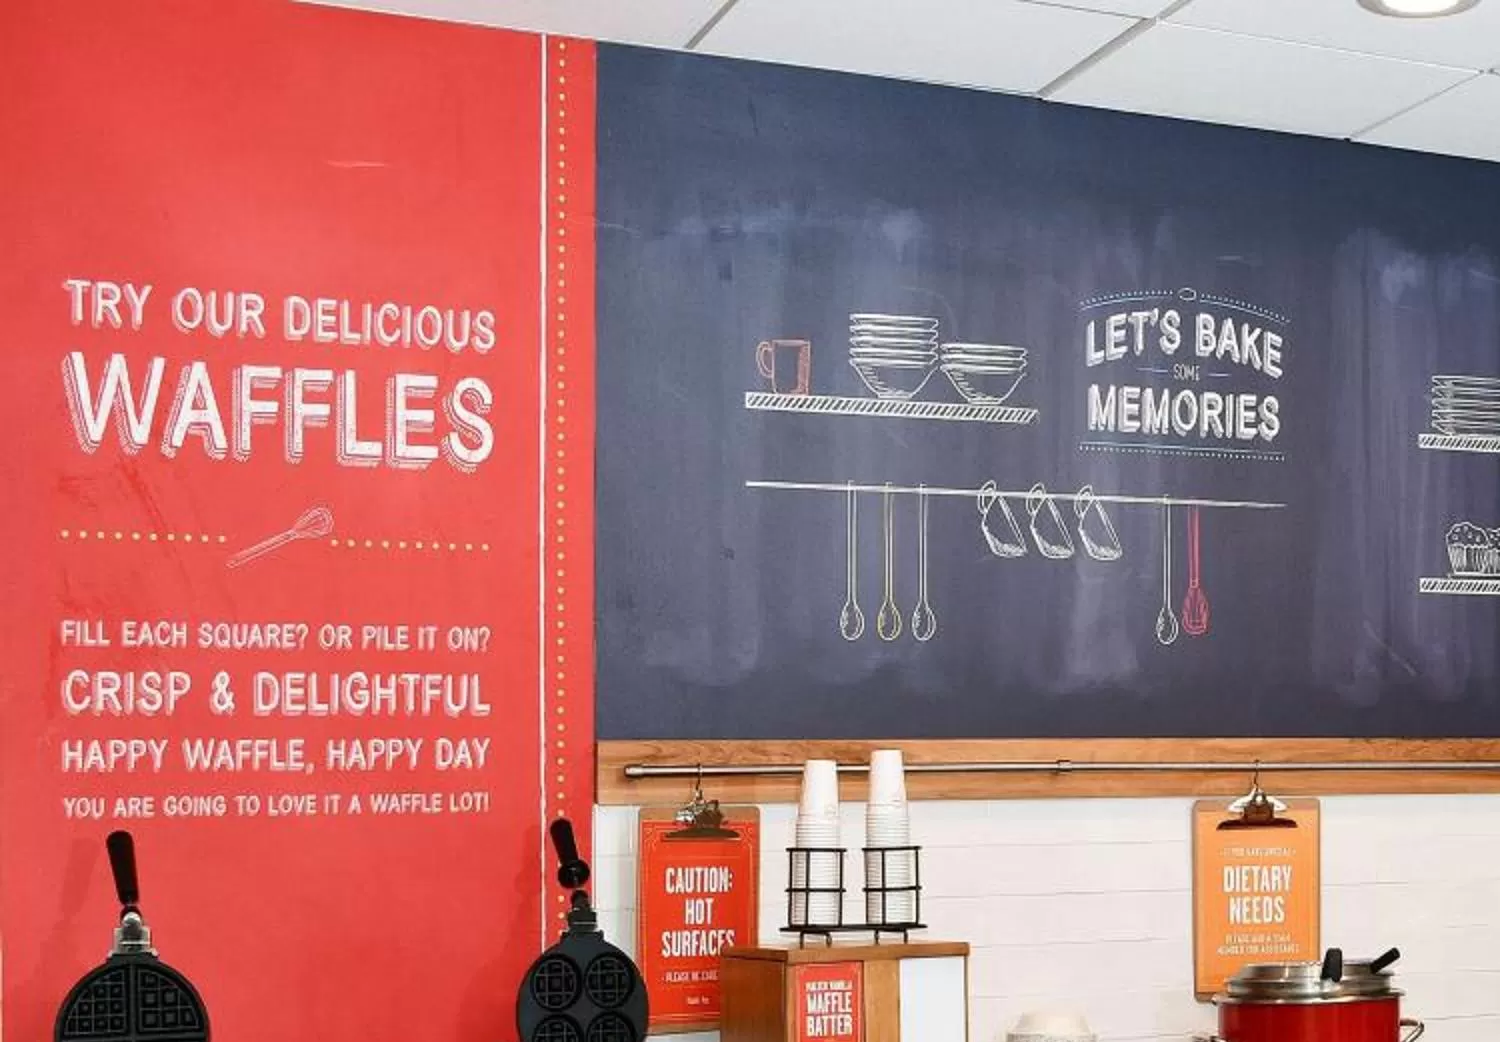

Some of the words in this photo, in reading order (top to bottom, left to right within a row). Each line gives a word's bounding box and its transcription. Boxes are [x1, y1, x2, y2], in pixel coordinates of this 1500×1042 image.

[63, 279, 152, 330] TRY
[172, 287, 266, 338] OUR
[284, 295, 495, 353] DELICIOUS
[1086, 308, 1181, 367] LET'S
[1195, 313, 1283, 379] BAKE
[1173, 364, 1201, 381] SOME
[61, 351, 494, 473] WAFFLES
[1088, 384, 1280, 442] MEMORIES
[61, 619, 111, 647] FILL
[122, 621, 187, 647] EACH
[199, 622, 309, 649] SQUARE?
[319, 623, 352, 650] OR
[362, 625, 410, 651] PILE
[417, 626, 439, 651] IT
[448, 626, 491, 652] ON?
[61, 670, 191, 716] CRISP
[210, 671, 235, 716] &
[253, 671, 491, 718] DELIGHTFUL
[62, 739, 168, 773] HAPPY
[182, 738, 315, 775] WAFFLE,
[326, 738, 423, 771] HAPPY
[435, 738, 490, 771] DAY
[64, 797, 105, 819] YOU
[114, 797, 155, 818] ARE
[163, 796, 226, 817] GOING
[235, 796, 260, 816] TO
[269, 794, 317, 816] LOVE
[323, 795, 341, 815] IT
[348, 795, 361, 815] A
[370, 793, 443, 815] WAFFLE
[665, 866, 734, 894] CAUTION:
[1223, 865, 1292, 893] DIETARY
[685, 898, 714, 925] HOT
[1229, 896, 1285, 924] NEEDS
[807, 991, 853, 1013] WAFFLE
[807, 1014, 853, 1037] BATTER
